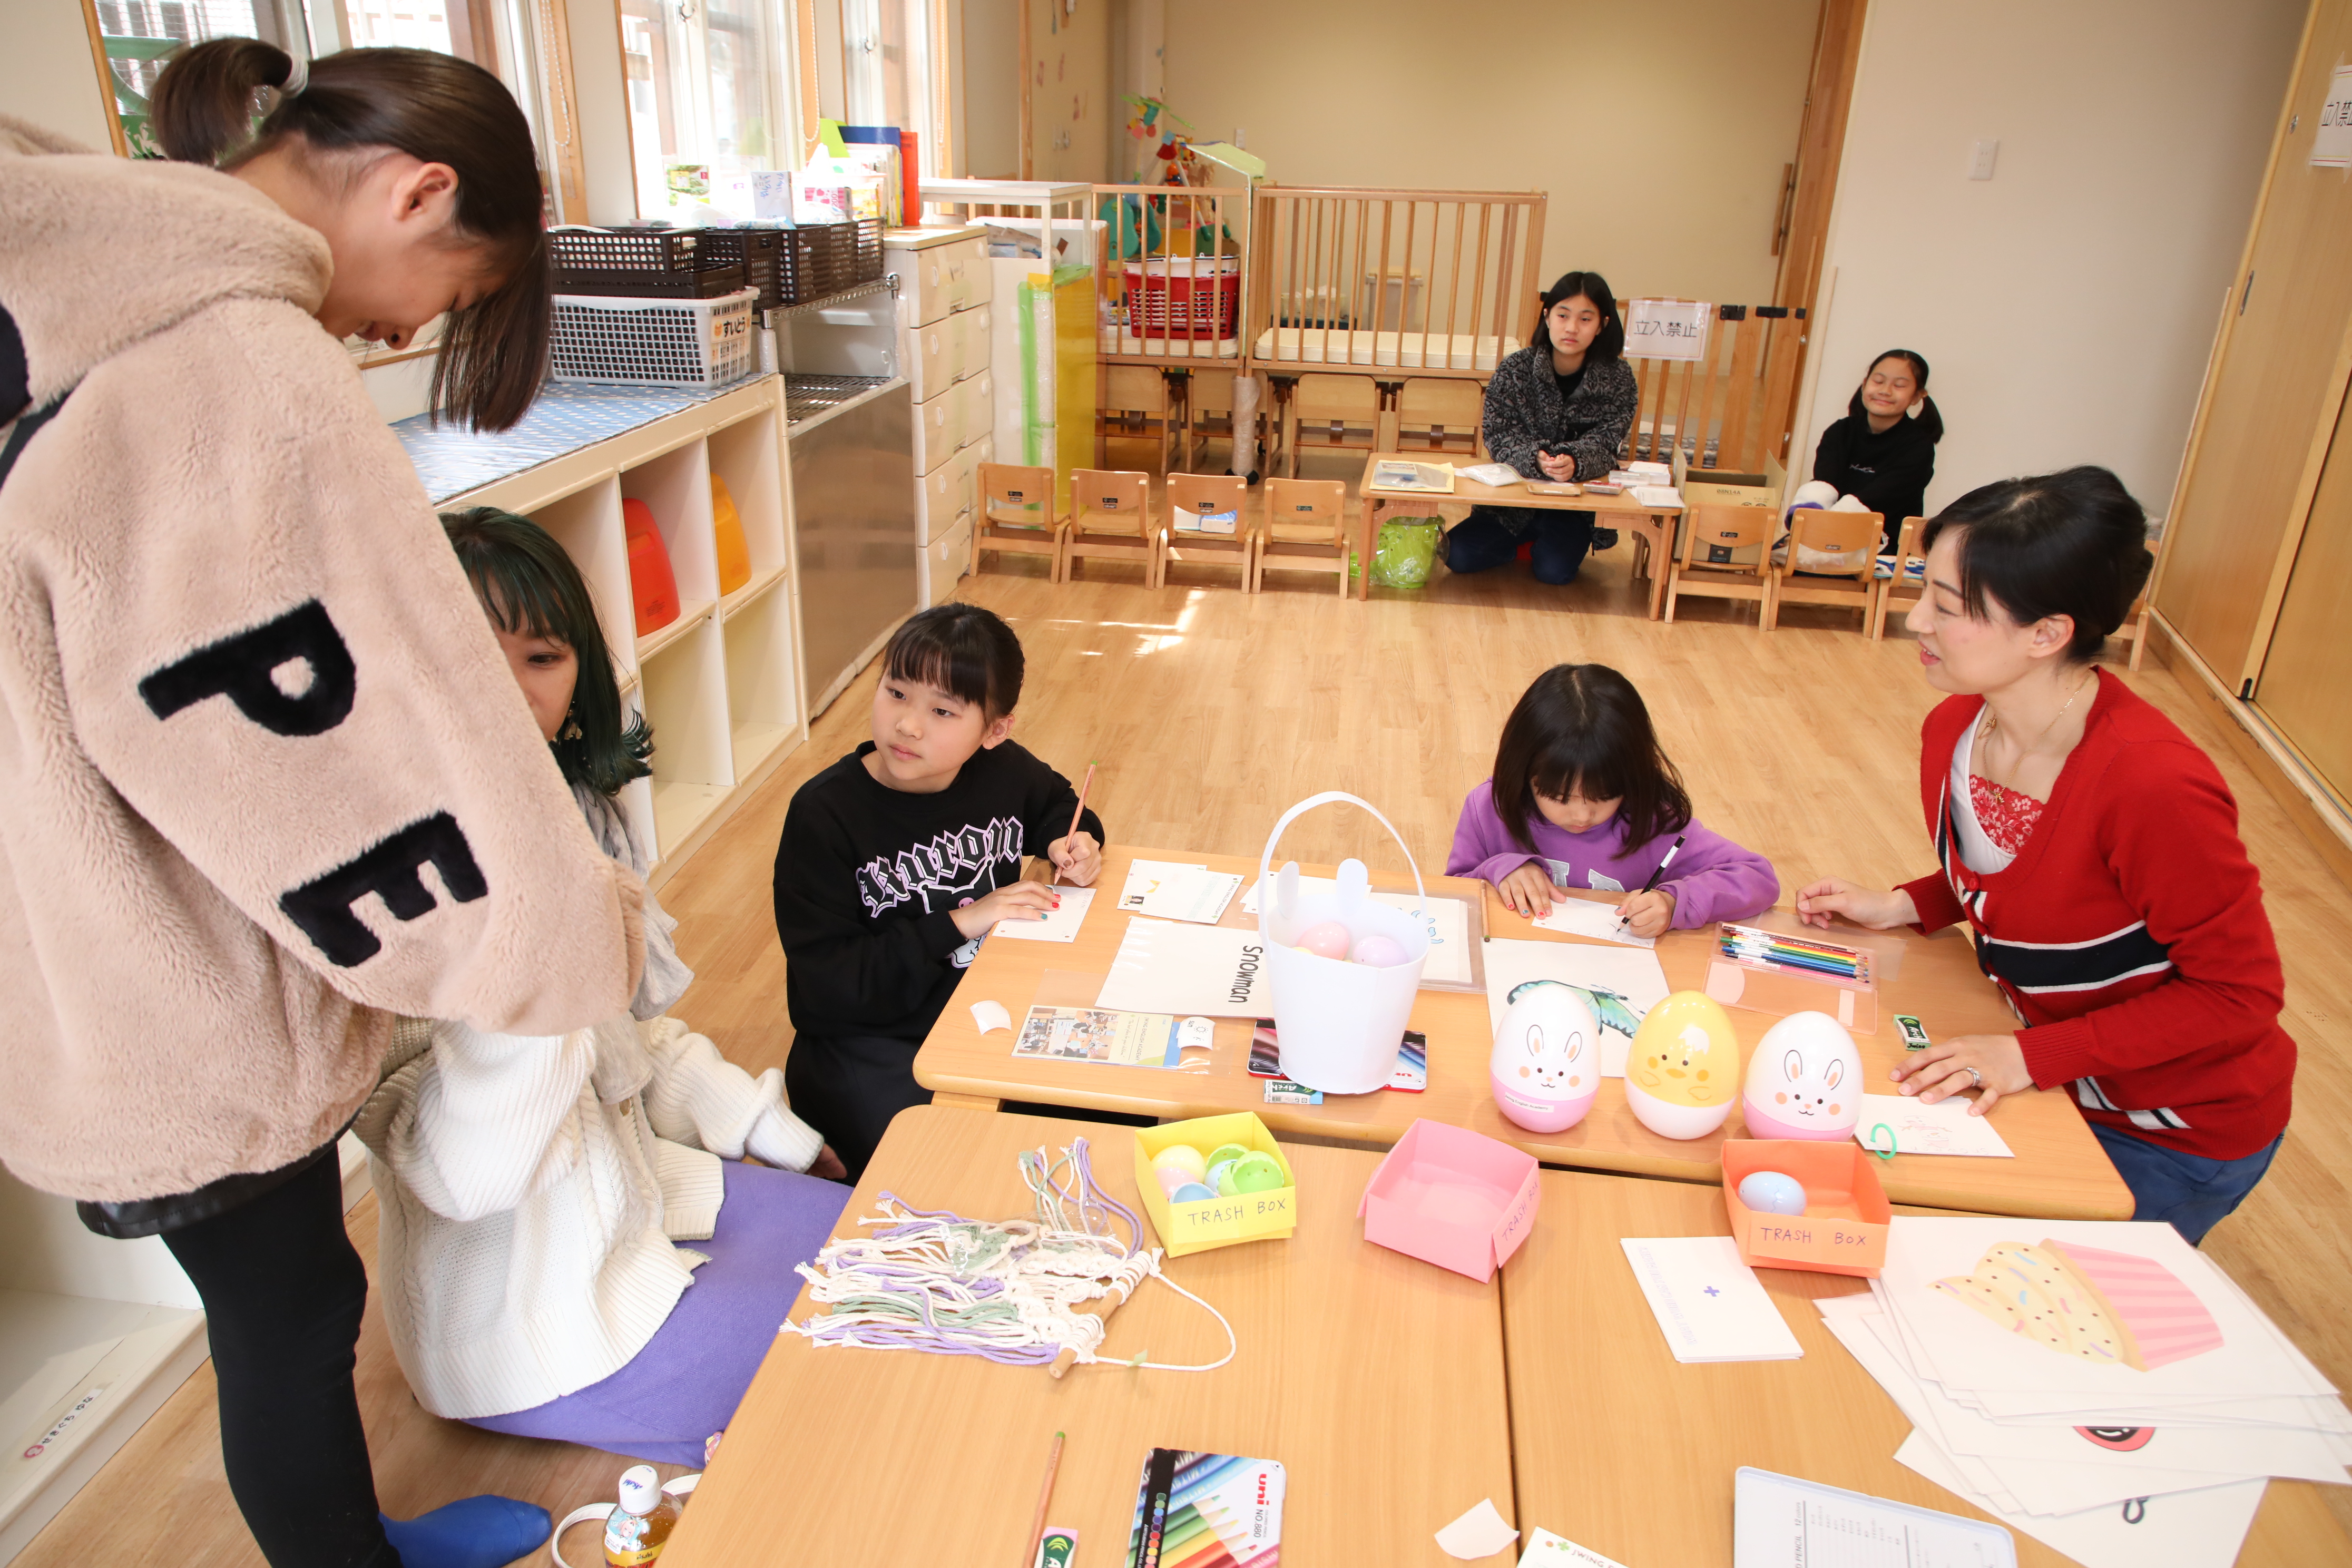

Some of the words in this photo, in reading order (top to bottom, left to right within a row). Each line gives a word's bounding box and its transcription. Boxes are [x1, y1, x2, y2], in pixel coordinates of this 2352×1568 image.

[723, 317, 746, 337] すいとう
[1634, 320, 1698, 338] 立入禁止
[1908, 1026, 1923, 1038] Arch
[1188, 1205, 1243, 1226] TRASH
[1258, 1198, 1286, 1214] BOX
[1502, 1200, 1527, 1241] TRASH
[1760, 1227, 1811, 1243] TRASH
[42, 1415, 75, 1444] せきぐち
[622, 1478, 643, 1490] Asahi
[1257, 1473, 1269, 1506] uni
[1253, 1509, 1263, 1538] NO.880
[1795, 1516, 1802, 1526] 12
[636, 1551, 652, 1560] Asahi
[1794, 1535, 1802, 1561] PENCIL
[1571, 1549, 1605, 1568] JWING
